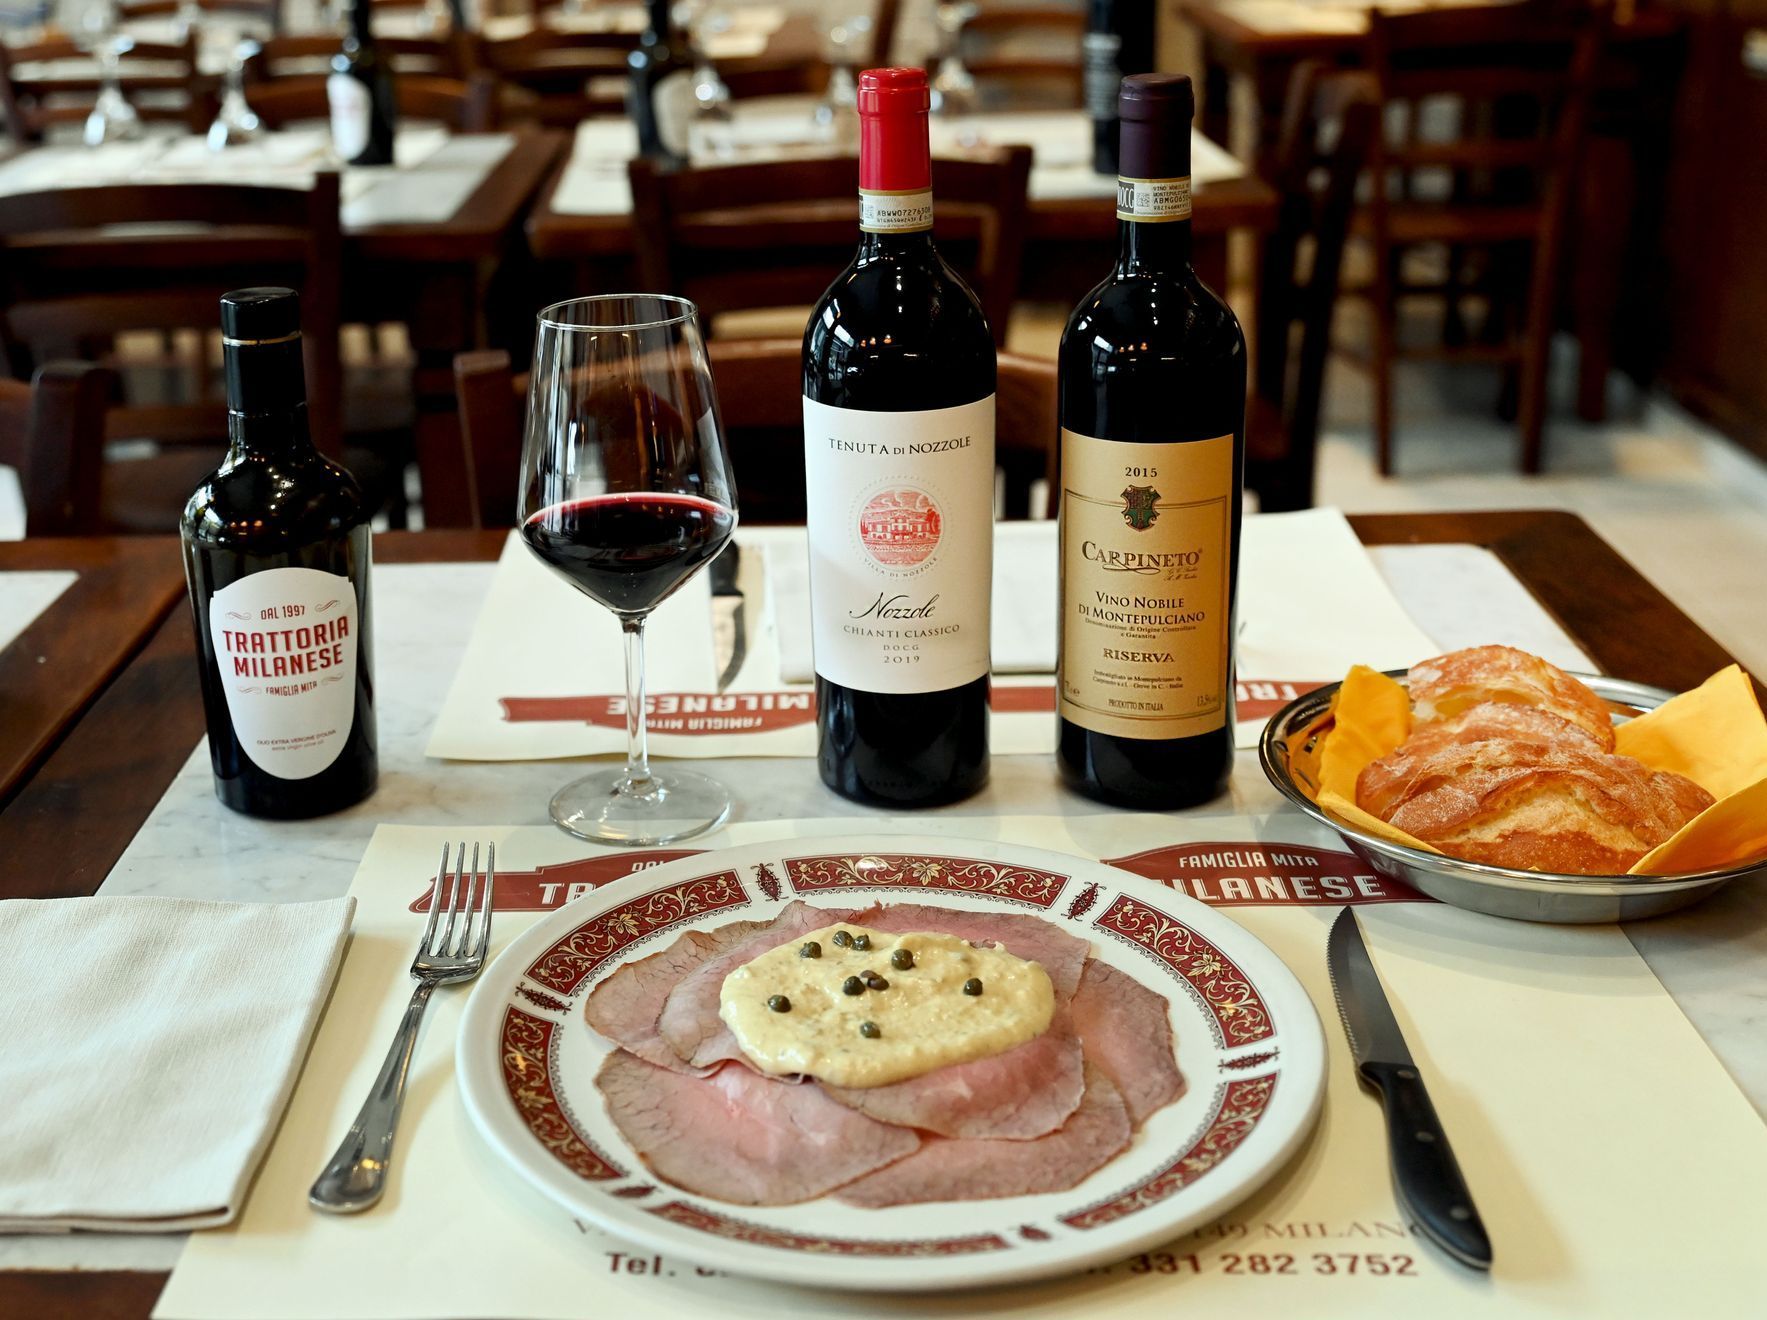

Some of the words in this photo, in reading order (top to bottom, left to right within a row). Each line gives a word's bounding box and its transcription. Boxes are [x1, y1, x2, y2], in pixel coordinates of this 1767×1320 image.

[828, 437, 889, 455] TENUTA
[909, 435, 972, 455] NOZZOLE
[1125, 466, 1158, 478] 2015
[1082, 541, 1200, 572] CARPINETO
[849, 591, 940, 620] Nozzole
[1096, 591, 1130, 608] VINO
[1134, 596, 1185, 609] NOBILE
[260, 607, 279, 620] DAL
[282, 605, 305, 619] 1997
[1078, 604, 1089, 616] DI
[1093, 607, 1205, 625] MONTEPULCIANO
[222, 615, 350, 654] TRATTORIA
[843, 625, 899, 638] CHIANTI
[904, 624, 960, 638] CLASSICO
[1136, 626, 1161, 634] Origine
[234, 643, 344, 678] MILANESE
[883, 655, 921, 664] 2019
[1103, 647, 1175, 663] RISERVA
[266, 684, 300, 696] FAMIGLIA
[301, 680, 318, 694] MITA
[1108, 698, 1138, 711] PRODOTTO
[688, 717, 763, 730] FAMIGLIA
[631, 861, 664, 872] DA
[1179, 851, 1267, 869] FAMIGLIA
[1270, 853, 1319, 867] MITA
[1152, 875, 1386, 901] ILANESE
[606, 1251, 676, 1277] Tel.
[1130, 1252, 1201, 1274] 331
[1220, 1253, 1298, 1275] 282
[1312, 1253, 1418, 1276] 3752
